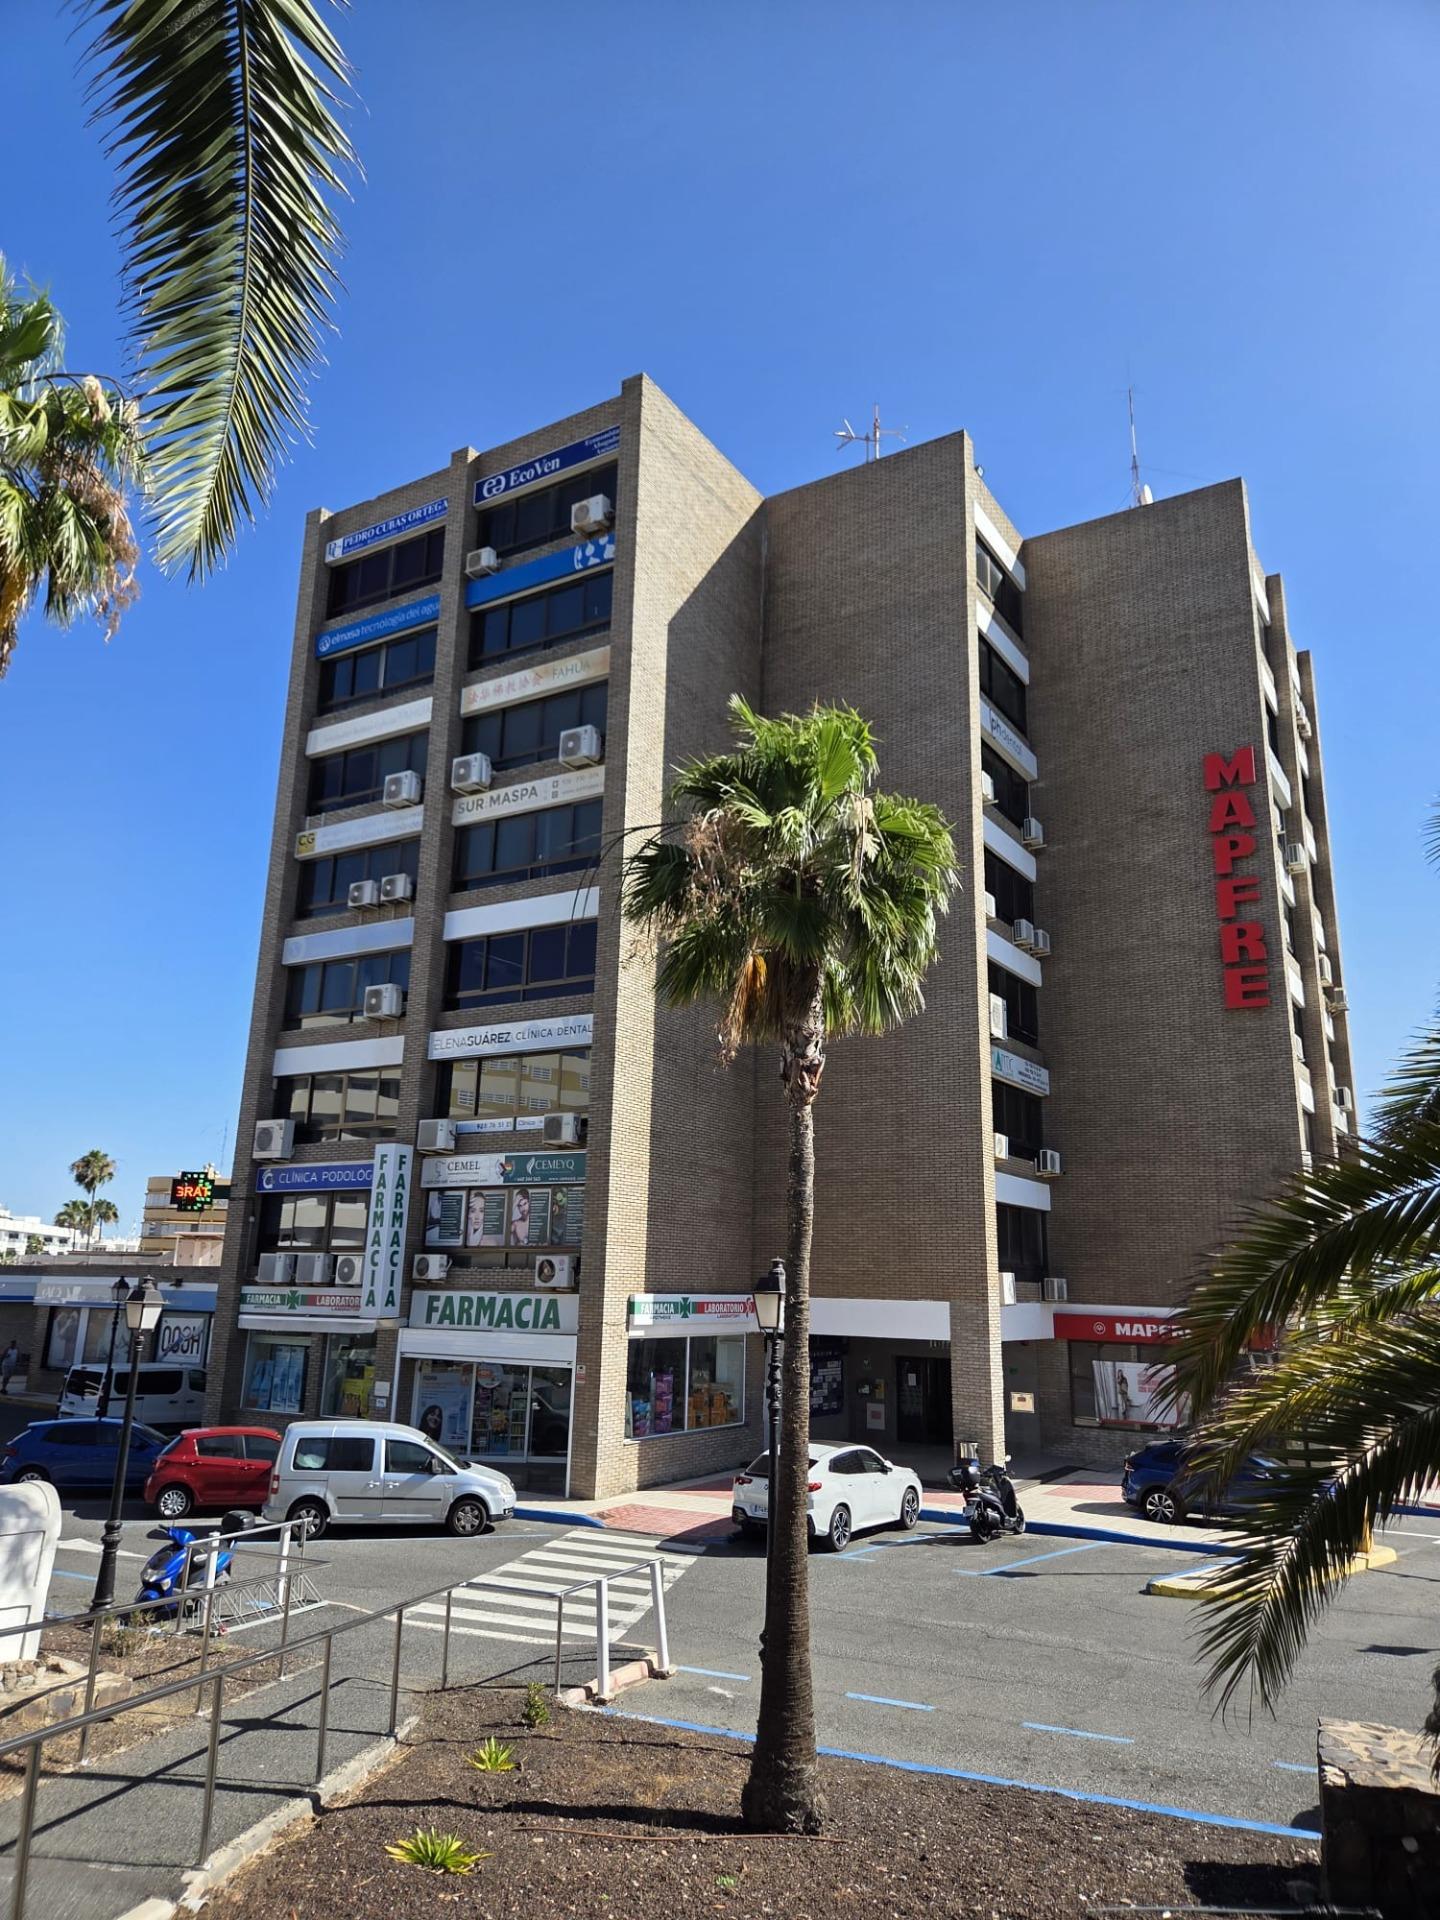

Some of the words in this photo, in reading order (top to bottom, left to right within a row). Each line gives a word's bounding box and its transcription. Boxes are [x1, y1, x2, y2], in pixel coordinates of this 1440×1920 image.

[509, 458, 560, 487] EcoVen
[343, 528, 375, 547] PEDRO
[375, 515, 407, 538] CUBAS
[408, 499, 448, 522] ORTEGA
[457, 798, 484, 814] SUR
[489, 786, 538, 807] MASPA
[1202, 745, 1270, 1010] MAPFRE
[515, 1028, 553, 1041] CLÍNICA
[557, 1024, 592, 1036] DENTAL
[447, 1160, 481, 1171] CEMEL
[534, 1159, 575, 1171] CEMEYQ
[279, 1170, 318, 1184] CLÍNICA
[365, 1154, 388, 1307] FARMACIA
[385, 1155, 407, 1307] FARMACIA
[246, 1294, 281, 1304] FARMACIA
[641, 1303, 674, 1314] FARMACIA
[704, 1303, 744, 1313] LABORATORIO
[425, 1295, 561, 1329] FARMACIA
